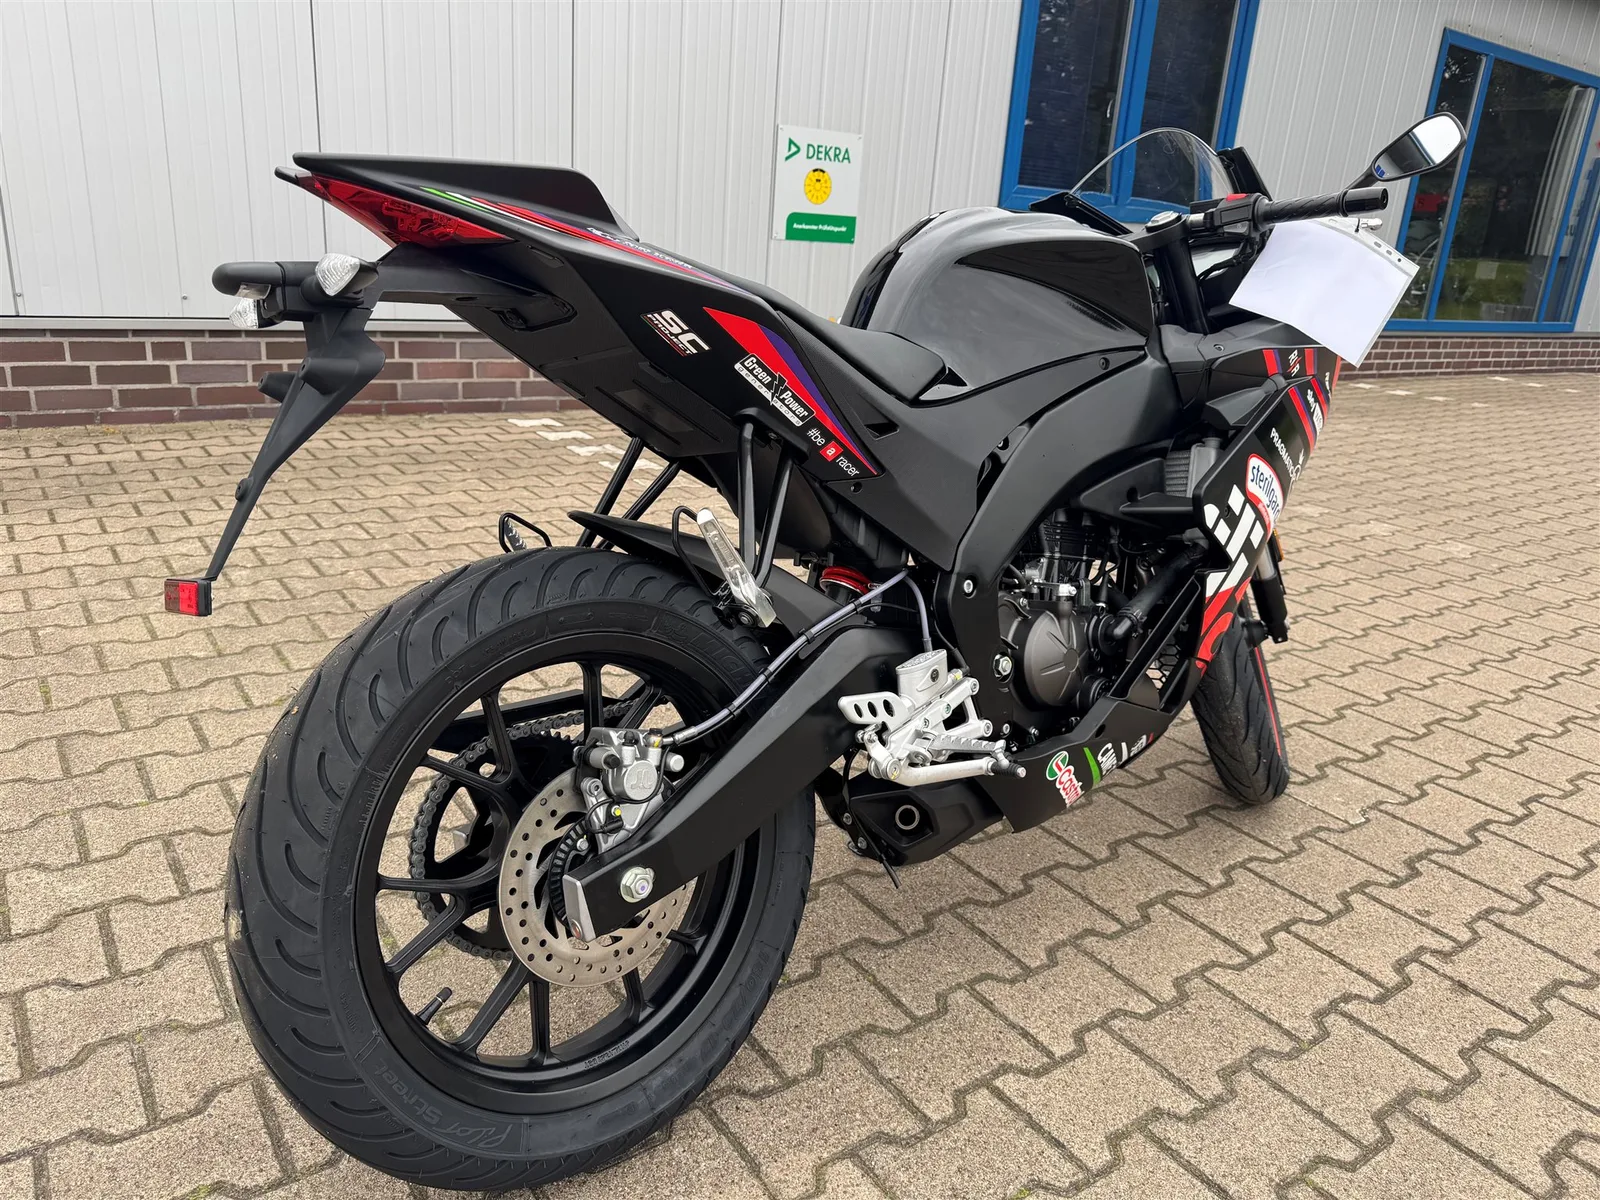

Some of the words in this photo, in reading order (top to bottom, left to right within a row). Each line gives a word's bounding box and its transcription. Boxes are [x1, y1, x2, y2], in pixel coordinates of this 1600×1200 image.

[805, 143, 851, 164] DEKRA
[646, 313, 693, 354] PROJECT
[661, 310, 710, 354] SC
[739, 366, 801, 425] generators
[743, 356, 772, 385] Green
[780, 390, 808, 418] Power
[807, 428, 826, 446] #be
[836, 456, 860, 477] racer
[1250, 463, 1280, 518] sterilgar
